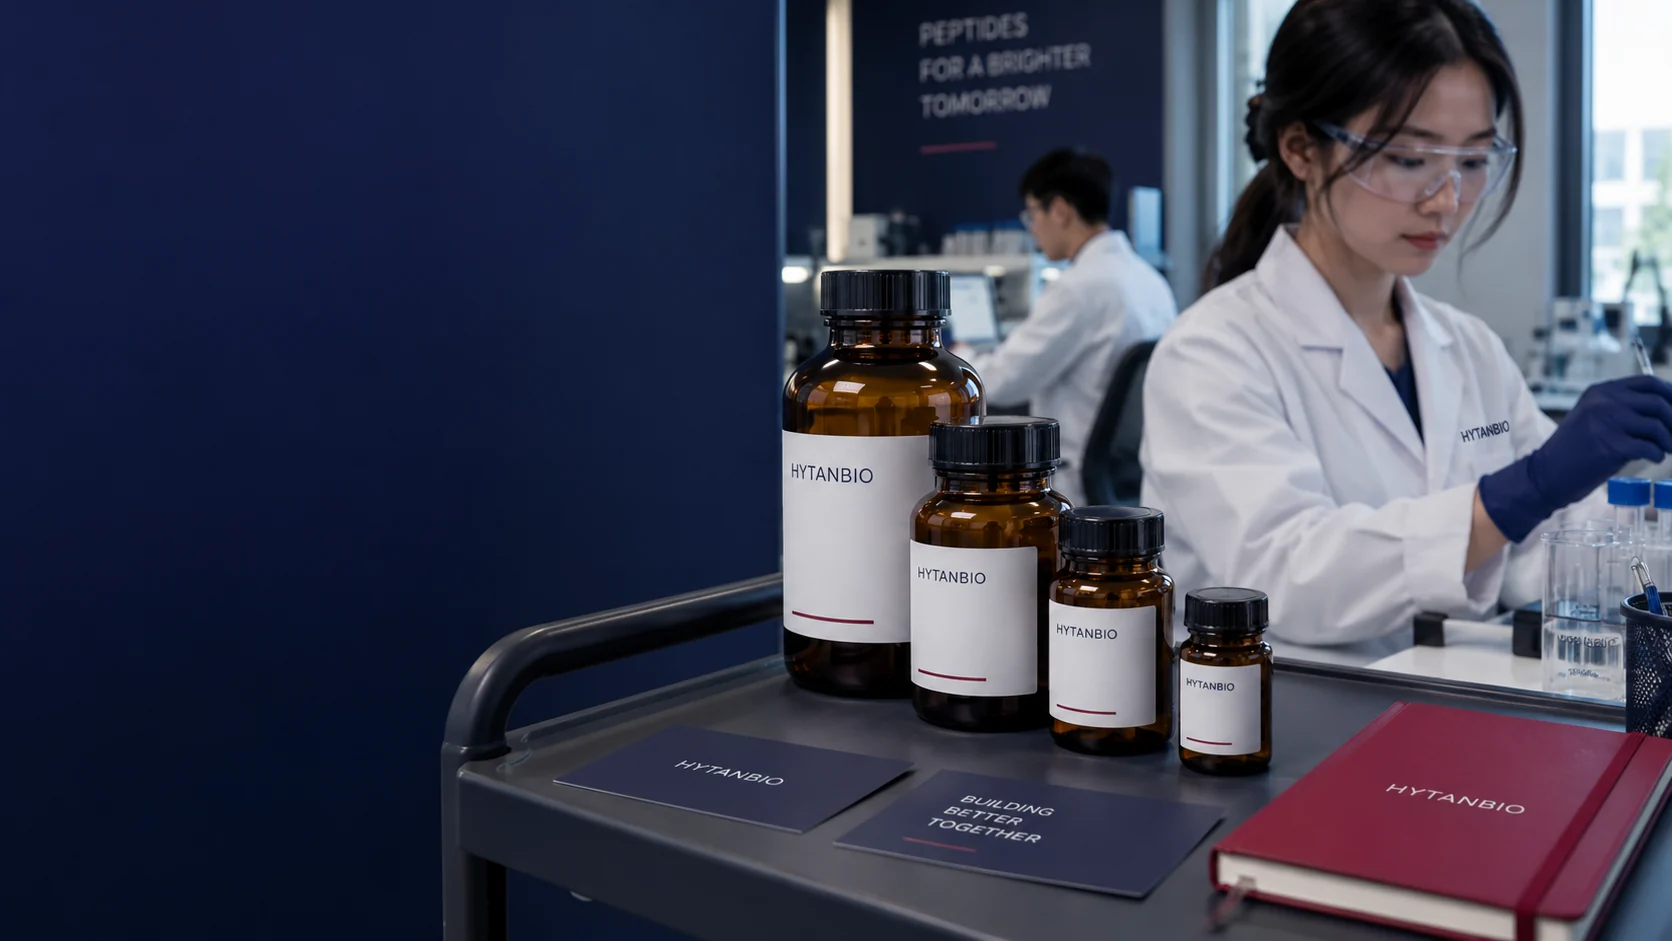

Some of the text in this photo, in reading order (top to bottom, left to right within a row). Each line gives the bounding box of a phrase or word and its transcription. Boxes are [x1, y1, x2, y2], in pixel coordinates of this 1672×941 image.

[919, 12, 1029, 47] PEPTIDES
[919, 42, 1092, 83] FOR A BRIGHTER
[920, 84, 1052, 119] TOMORROW
[1460, 420, 1510, 443] HYTANBIO
[791, 462, 874, 485] HYTANBIO
[917, 566, 987, 585] HYTANBIO
[1056, 623, 1118, 640] HYTANBIO
[1186, 677, 1235, 692] HYTANBIO
[674, 758, 785, 788] HYTANBIO
[960, 795, 1055, 817] BUILDING
[1385, 782, 1526, 815] HYTANBIO
[943, 806, 1023, 826] BETTER
[927, 817, 1042, 843] TOGETHER
